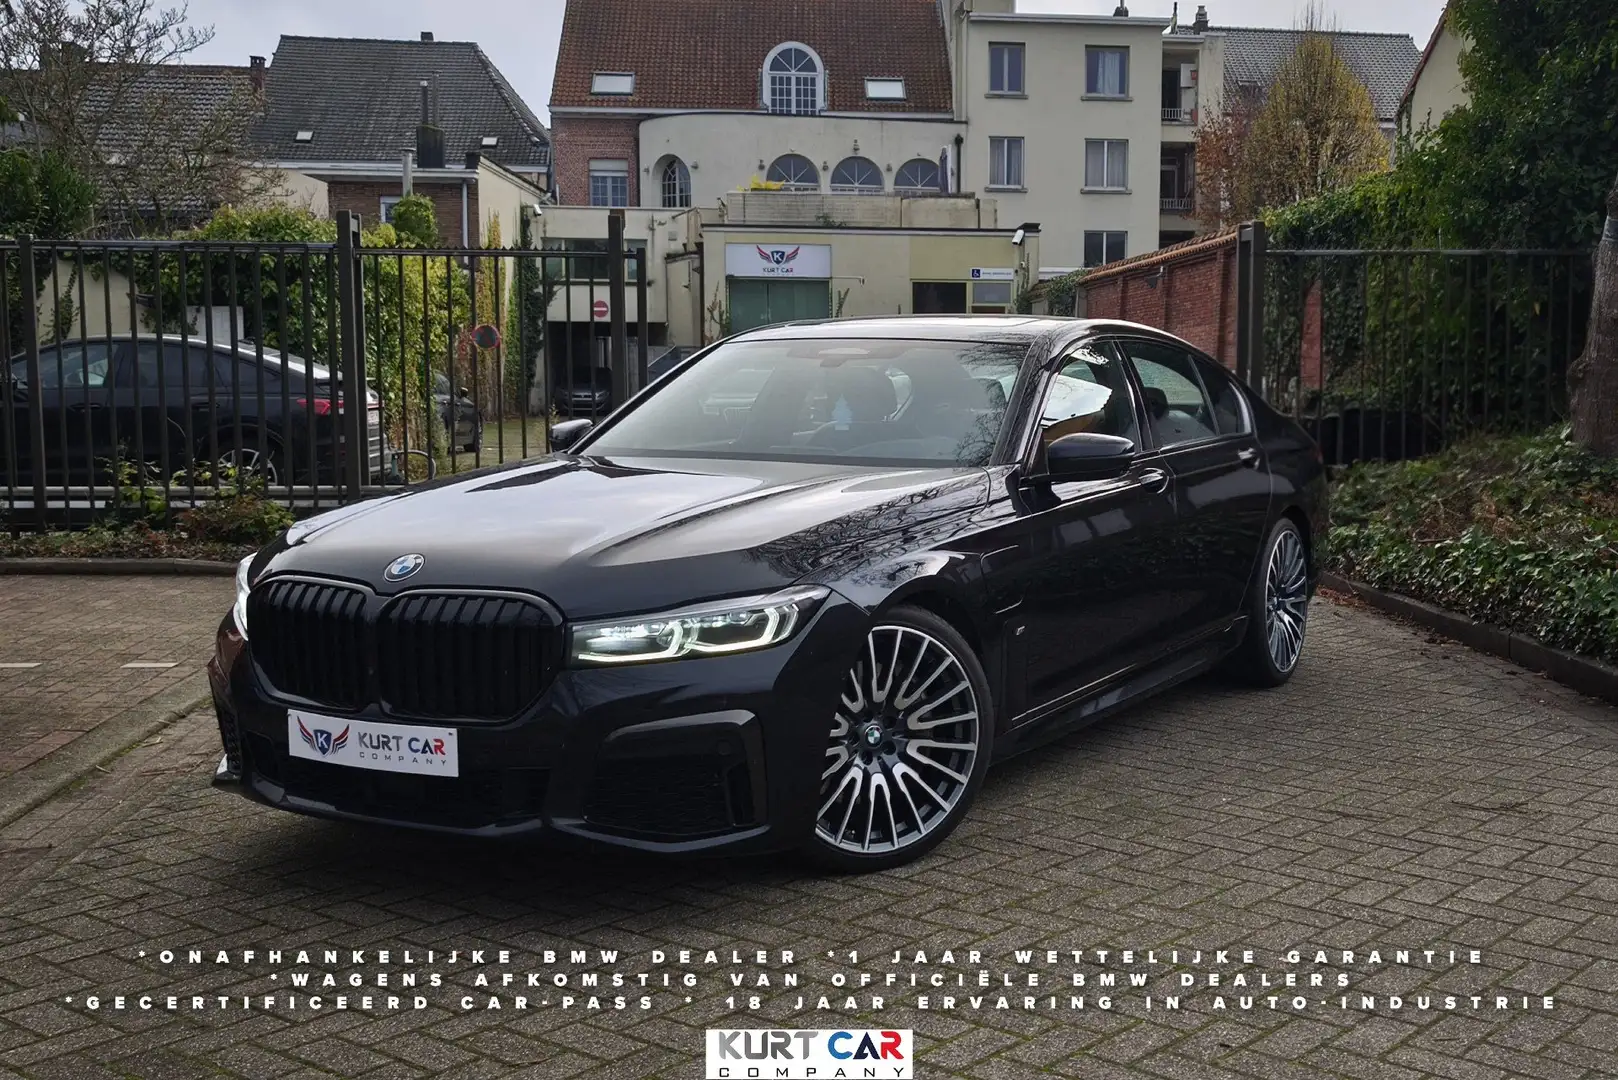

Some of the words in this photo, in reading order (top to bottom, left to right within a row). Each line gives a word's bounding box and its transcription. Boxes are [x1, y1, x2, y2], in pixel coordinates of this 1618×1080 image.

[358, 732, 403, 751] KURT
[408, 737, 446, 756] CAR
[359, 751, 447, 766] COMPANY
